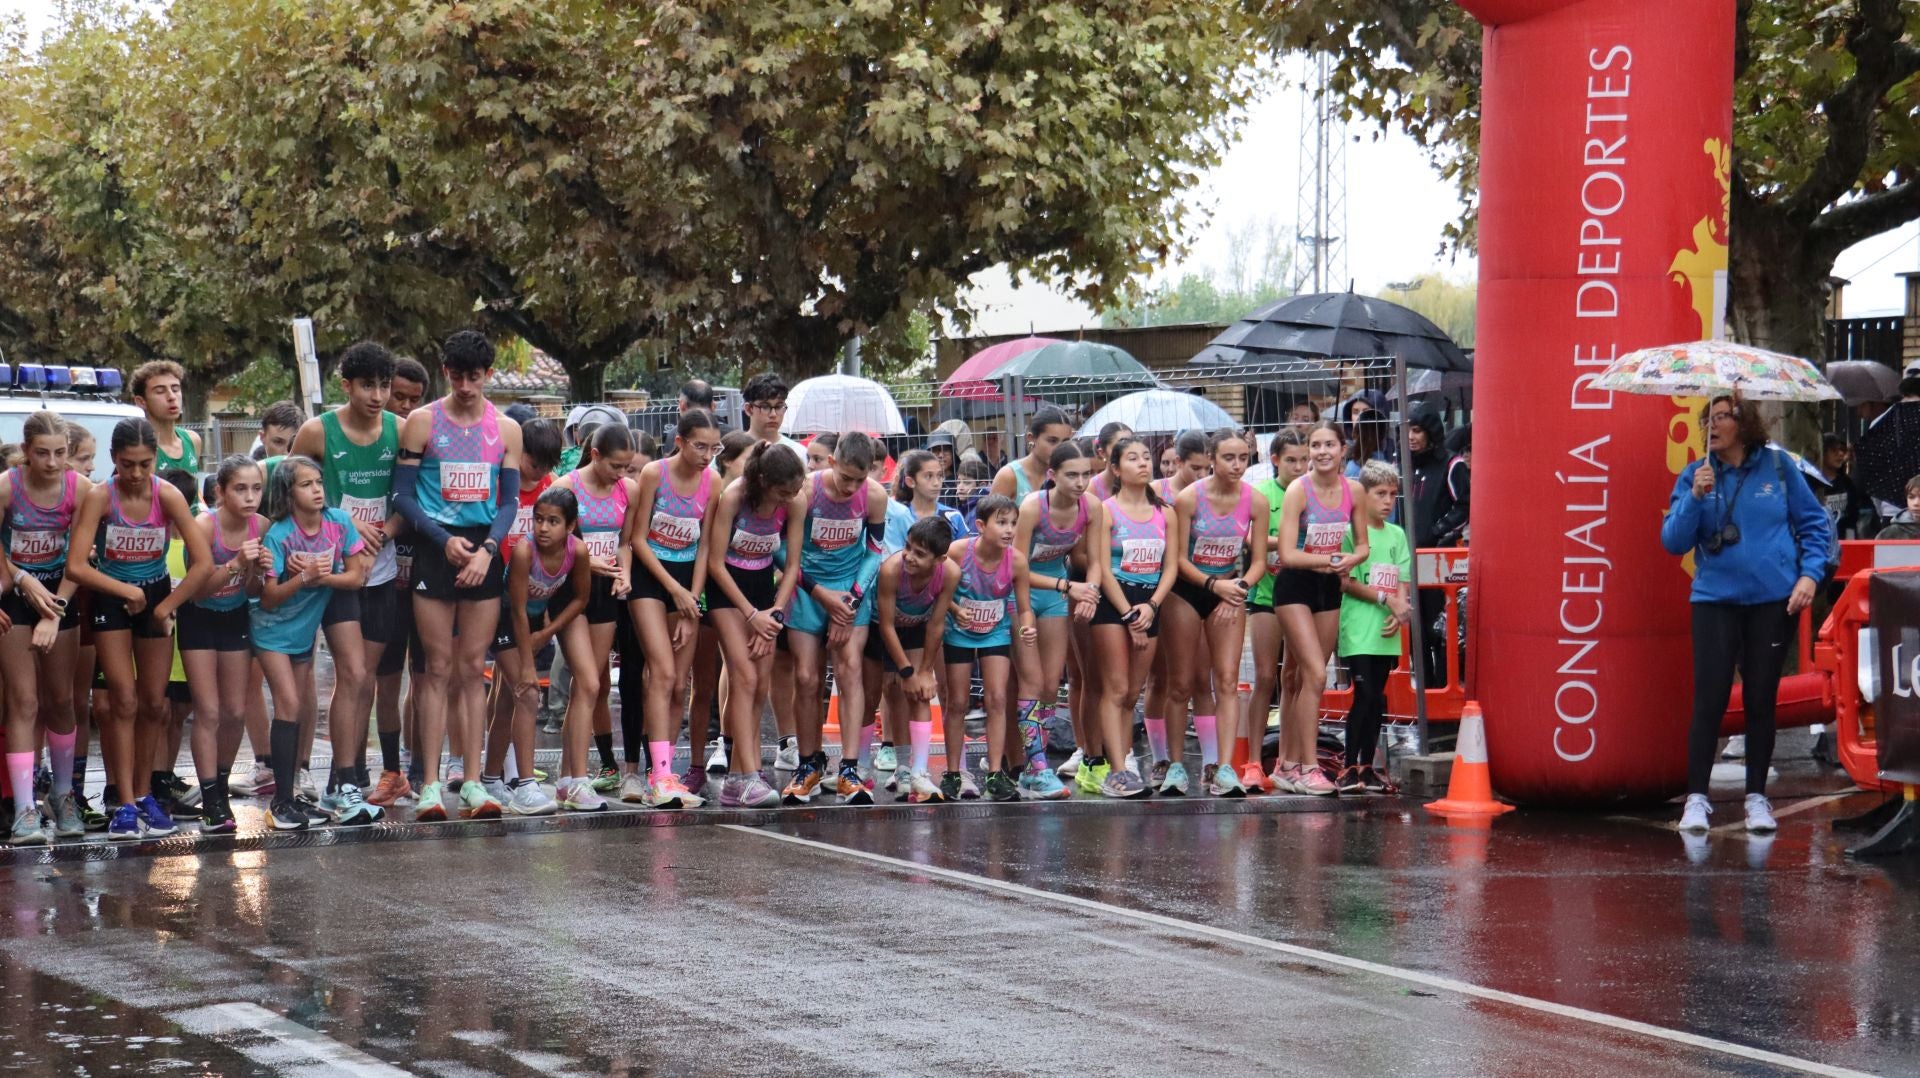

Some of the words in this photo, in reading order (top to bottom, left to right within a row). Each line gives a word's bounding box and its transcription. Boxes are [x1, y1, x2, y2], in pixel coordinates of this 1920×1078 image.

[1575, 44, 1632, 318] DEPORTES
[1570, 343, 1617, 410] DE
[349, 469, 391, 477] universidad
[449, 472, 483, 488] 2007
[351, 506, 379, 522] 2012
[659, 521, 692, 540] 2044
[820, 526, 854, 540] 2006
[116, 536, 155, 551] 2037
[1314, 531, 1342, 546] 2039
[738, 540, 773, 553] 2053
[1202, 544, 1235, 557] 2048
[1552, 433, 1613, 762] CONCEJALÍA
